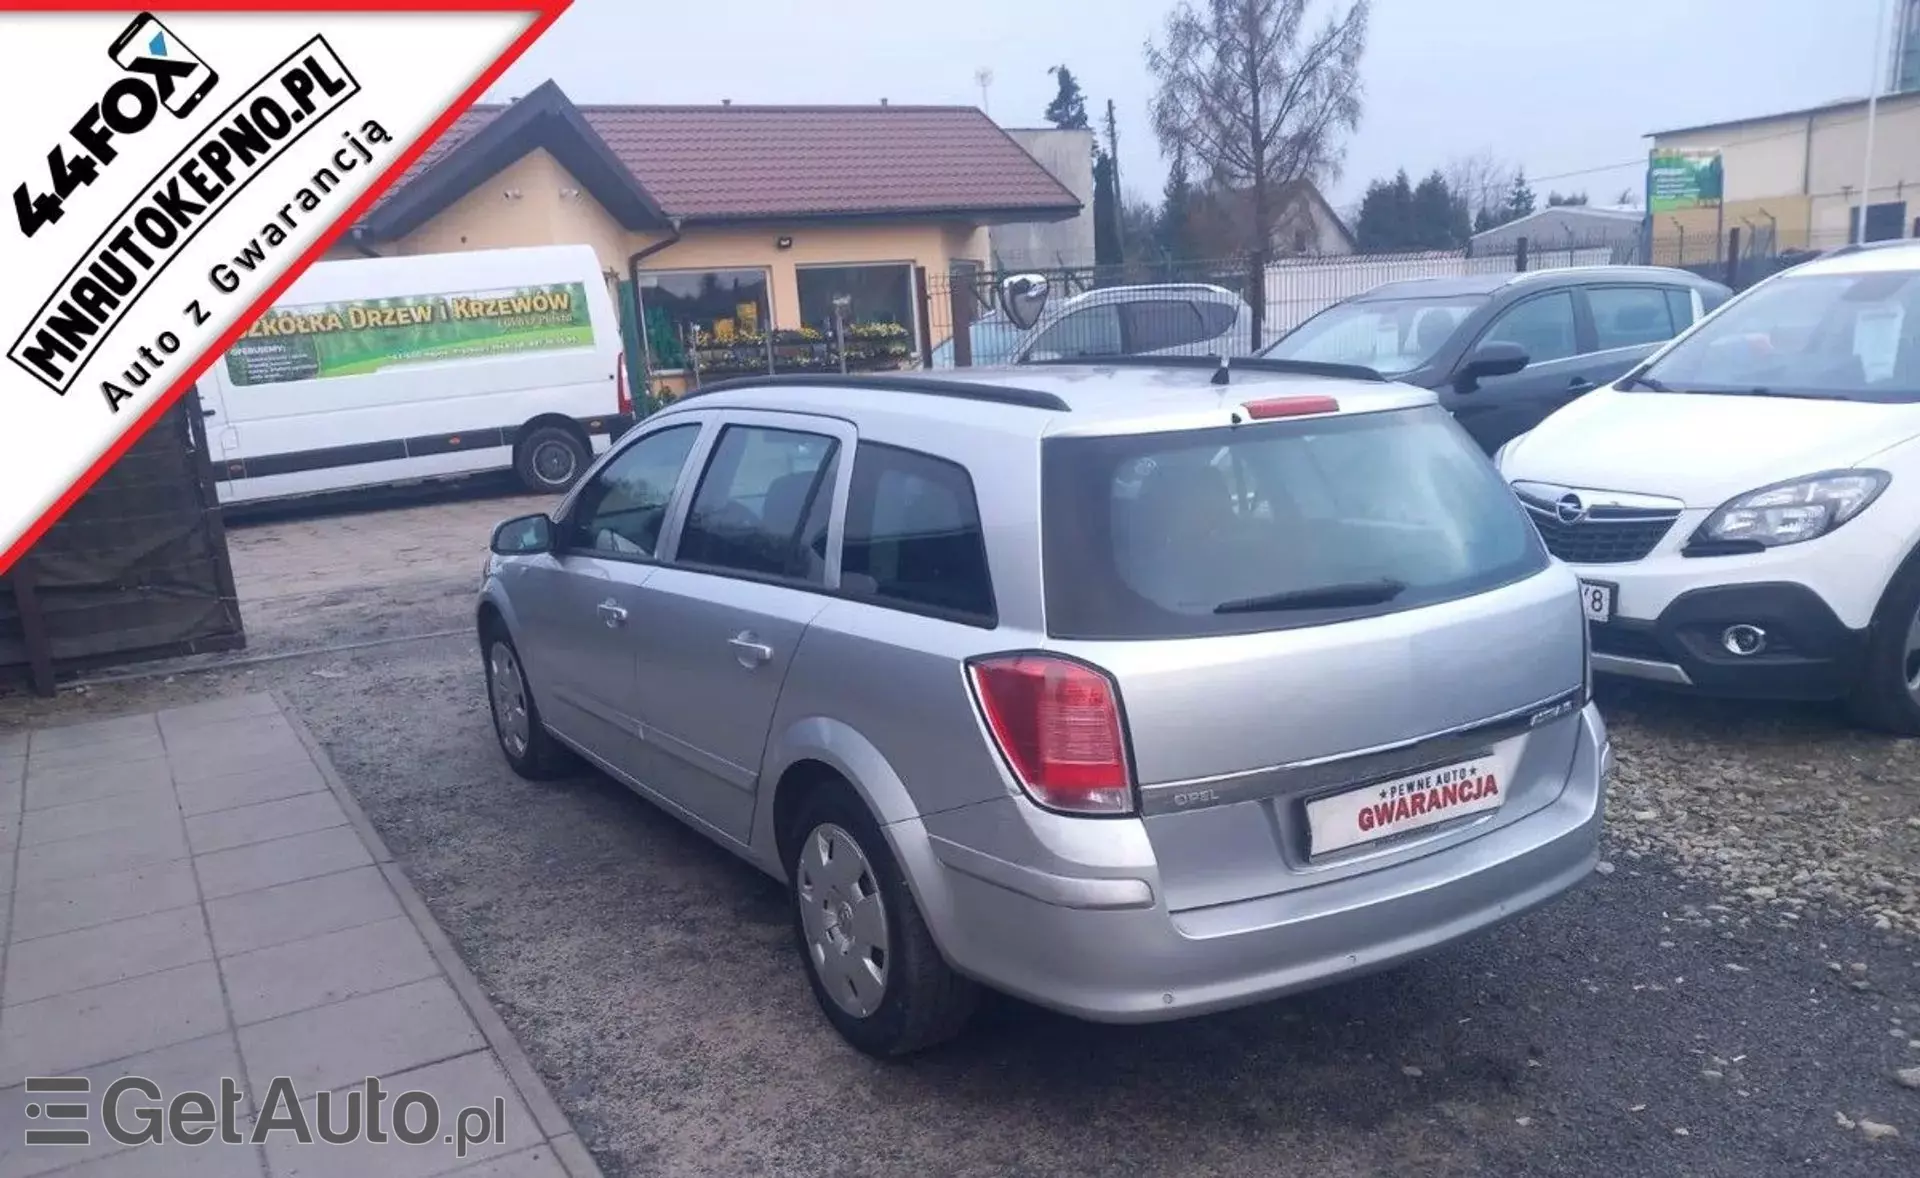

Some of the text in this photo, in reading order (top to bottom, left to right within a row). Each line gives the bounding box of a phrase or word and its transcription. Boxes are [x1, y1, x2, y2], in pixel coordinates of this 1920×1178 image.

[239, 309, 343, 339] ZKÓŁKA
[348, 304, 432, 329] DRZEW
[453, 289, 572, 319] KRZEWÓW
[1357, 773, 1500, 832] GWARANCJA
[1390, 767, 1467, 799] PEWNE AUTO
